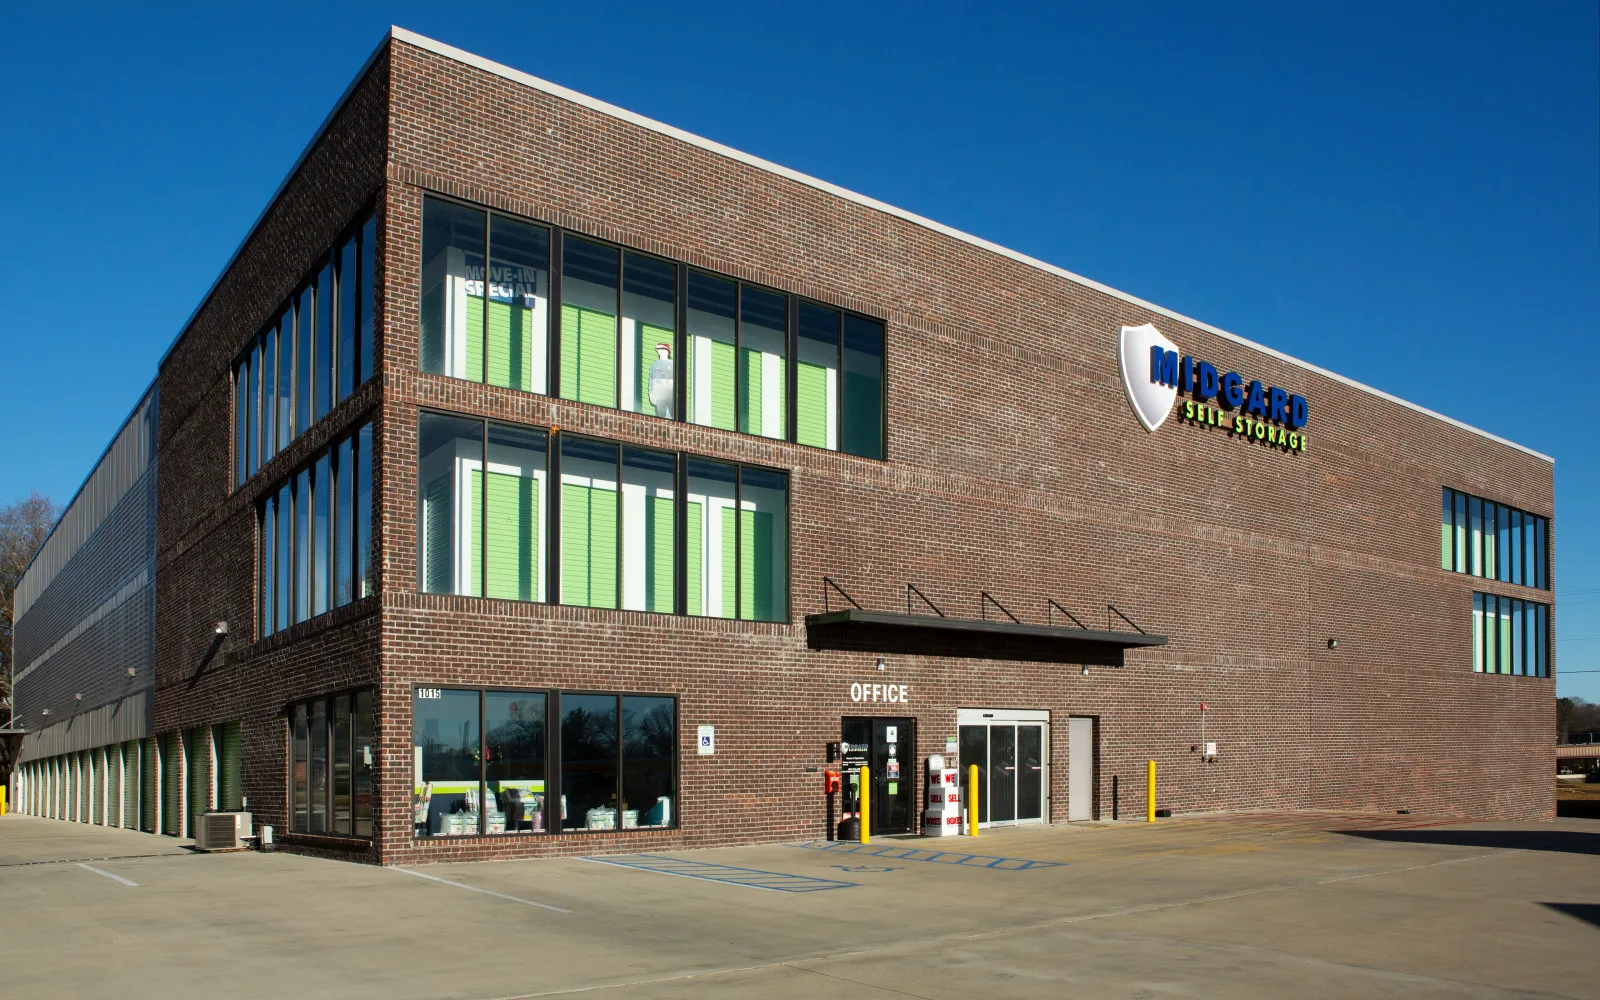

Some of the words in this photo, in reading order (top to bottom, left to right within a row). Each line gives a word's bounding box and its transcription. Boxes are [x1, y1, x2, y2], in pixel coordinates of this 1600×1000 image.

[465, 265, 535, 283] MOVE-IN
[465, 280, 535, 298] SPECIAL
[1150, 344, 1308, 428] MIDGARD
[1183, 401, 1224, 427] SELF
[1233, 416, 1307, 452] STORAGE
[420, 688, 440, 698] 1015
[850, 682, 908, 703] OFFICE
[930, 774, 940, 784] WE
[944, 773, 955, 784] WE
[930, 794, 942, 803] SELL
[947, 793, 961, 803] SELL
[925, 816, 941, 825] BOXES
[946, 816, 963, 825] BOXES
